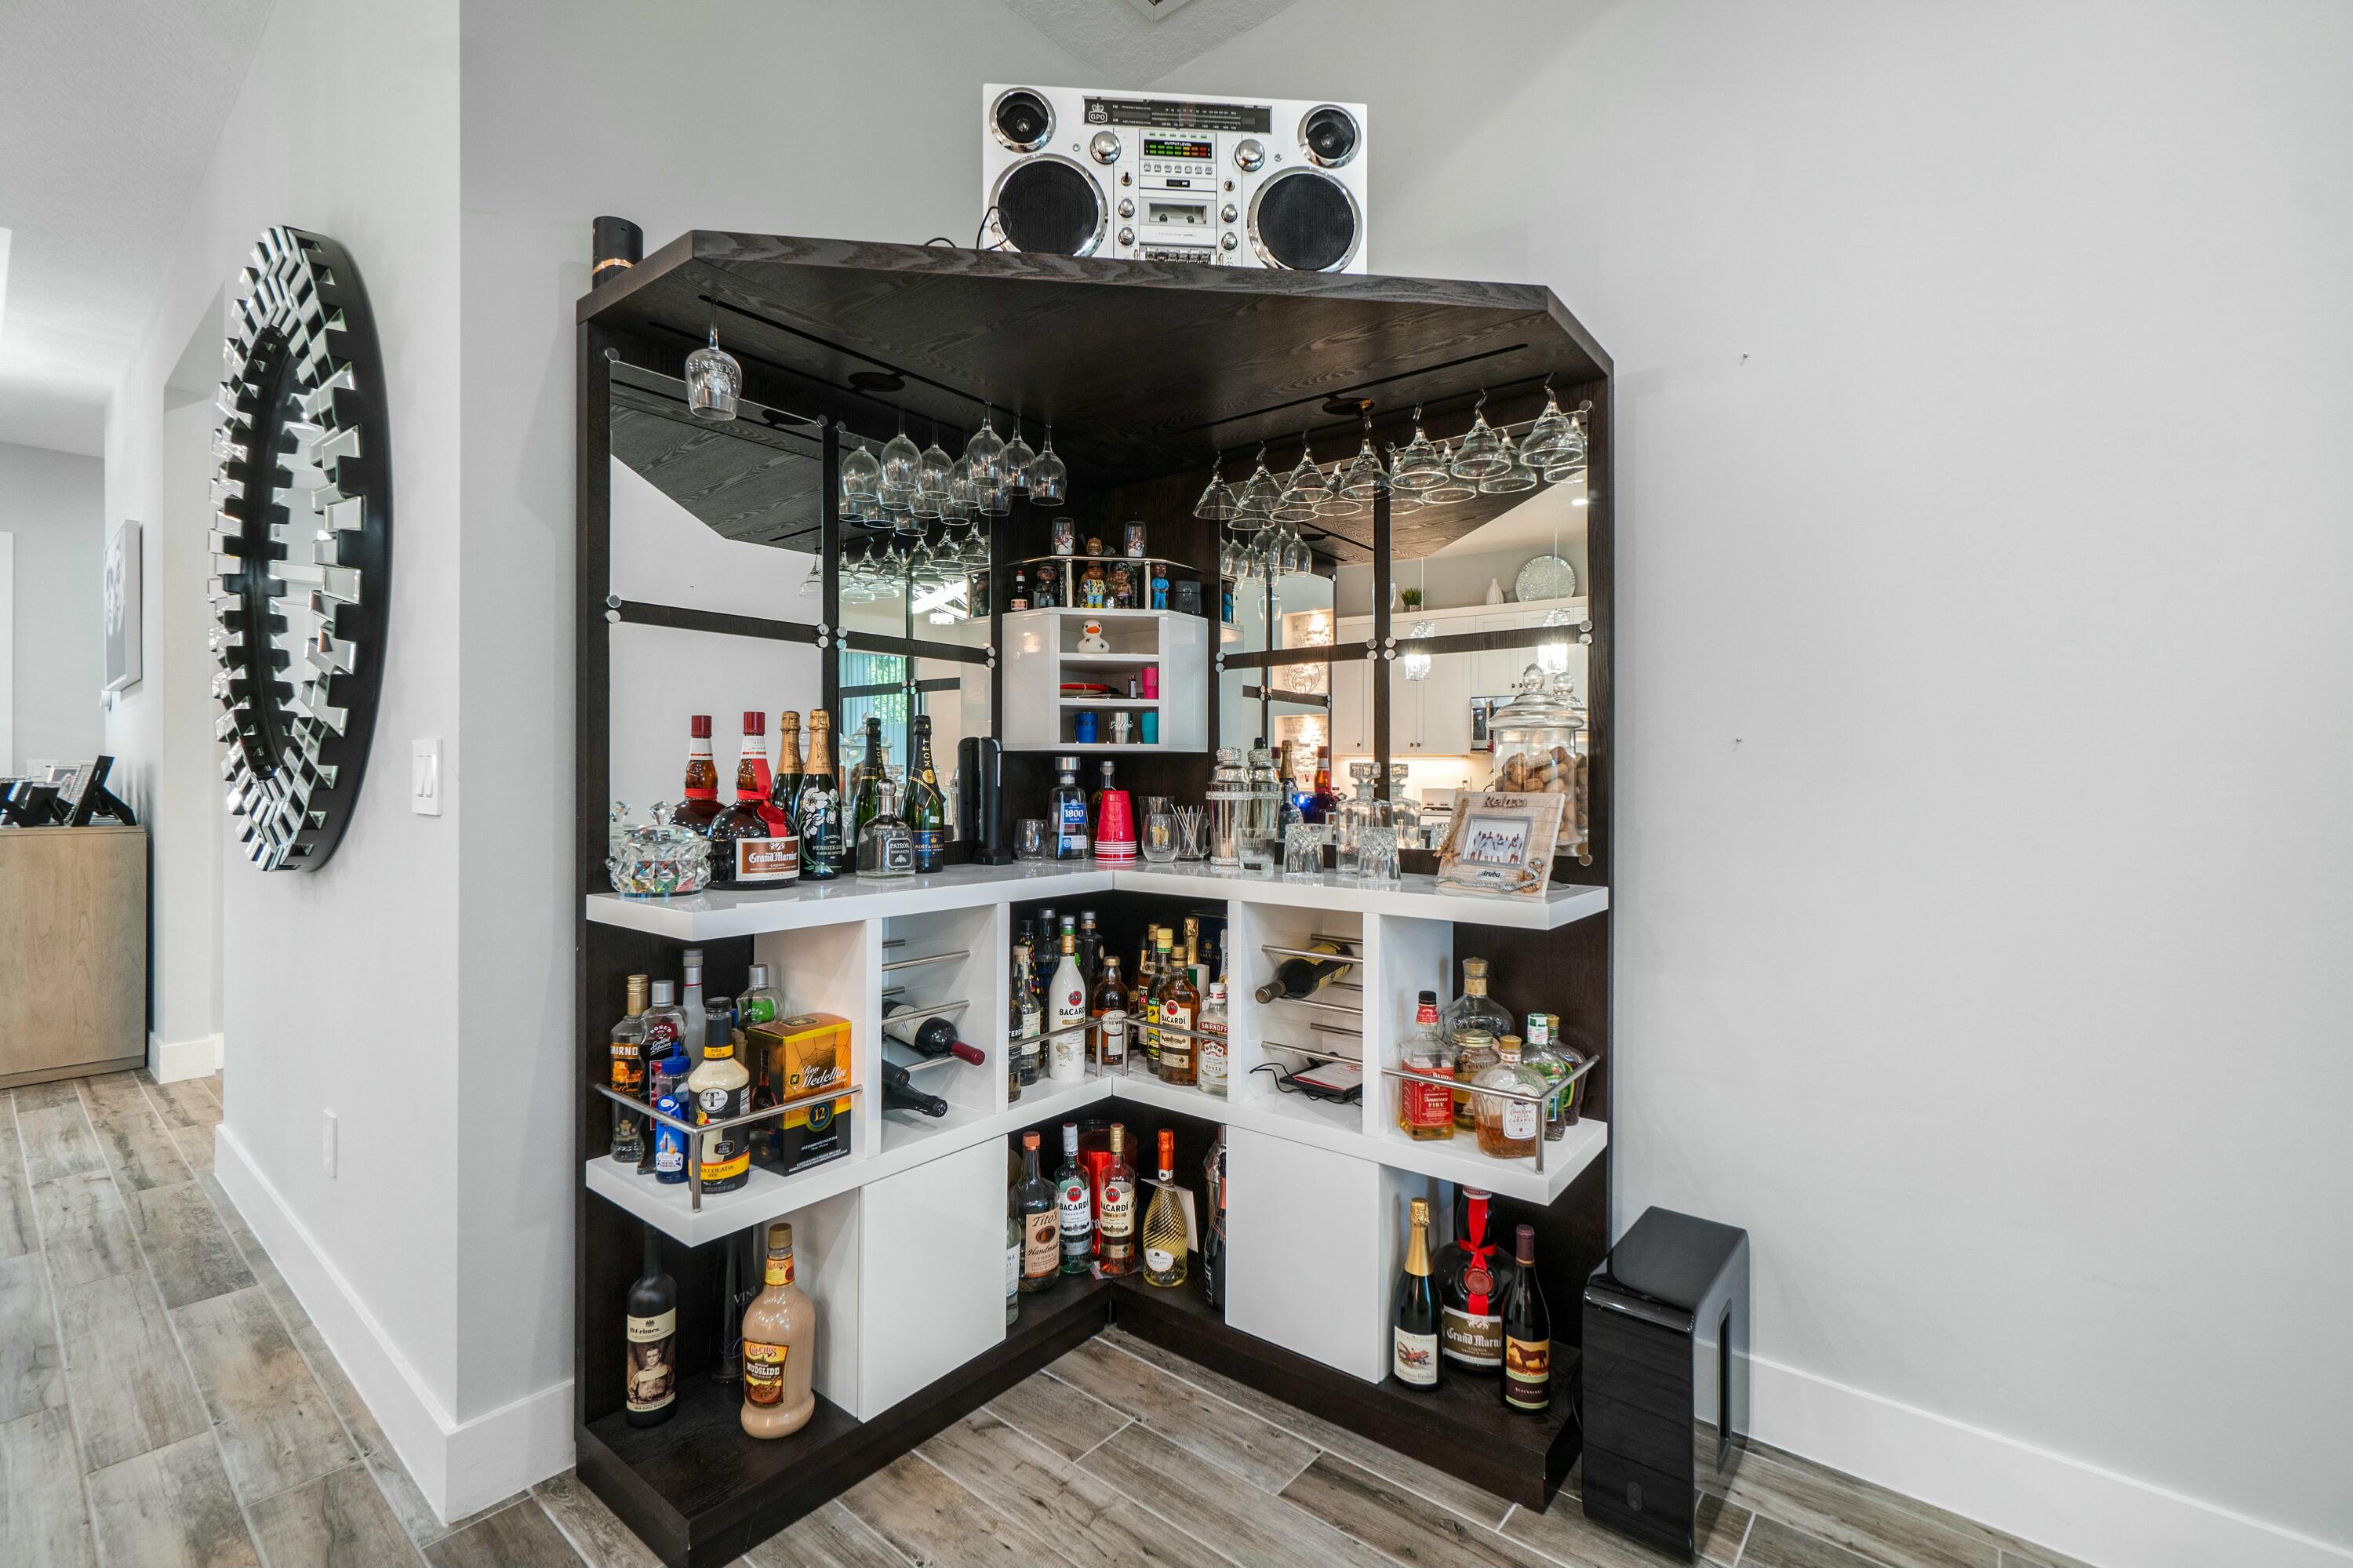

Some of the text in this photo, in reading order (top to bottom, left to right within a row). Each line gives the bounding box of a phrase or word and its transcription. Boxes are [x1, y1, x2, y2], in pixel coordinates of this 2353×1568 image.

[1064, 809, 1084, 817] 1800
[748, 851, 797, 863] Grand Marnier
[1059, 1007, 1086, 1016] BACARD
[1162, 1014, 1186, 1025] BACARDÍ
[1201, 1023, 1227, 1032] SMIRNOFF
[802, 1065, 820, 1075] Ron
[706, 1092, 719, 1108] T
[814, 1106, 826, 1122] 12
[707, 1165, 734, 1173] COLADA
[1032, 1210, 1058, 1228] Tito's
[1472, 1334, 1501, 1348] Marni
[747, 1362, 780, 1376] MUDSLIDE
